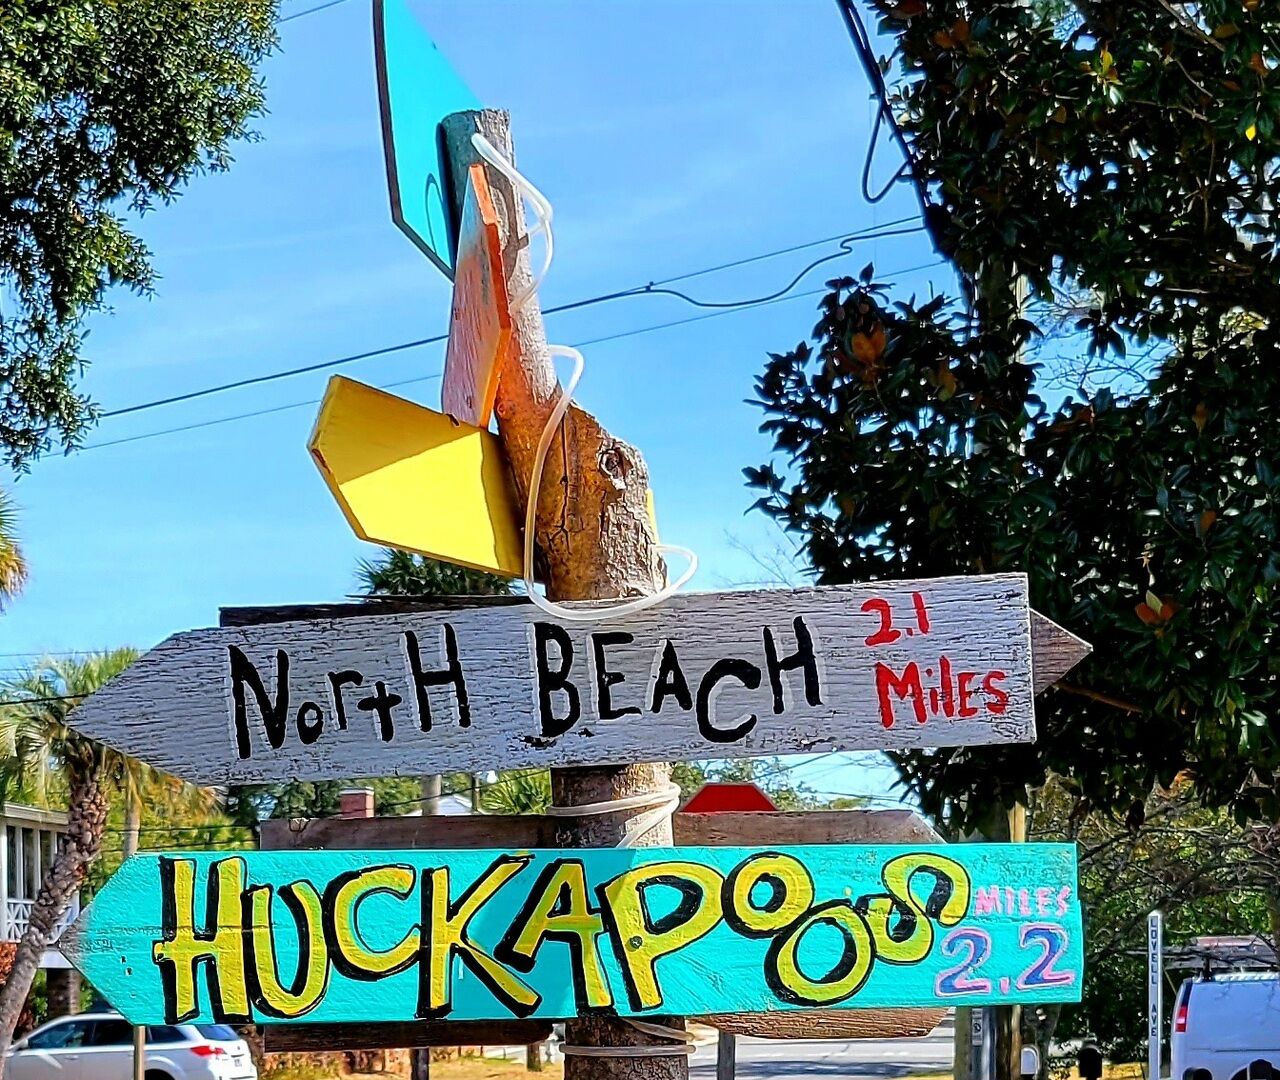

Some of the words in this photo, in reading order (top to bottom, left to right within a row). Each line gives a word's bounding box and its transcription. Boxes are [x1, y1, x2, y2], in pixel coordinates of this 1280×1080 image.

[860, 590, 931, 647] 2.1
[532, 614, 824, 744] BEACH
[974, 884, 1071, 918] MILES
[152, 852, 972, 1026] HUCKAPOOS
[934, 921, 1076, 998] 2.2
[1150, 915, 1158, 985] LOVELL
[1150, 1003, 1158, 1037] AVE
